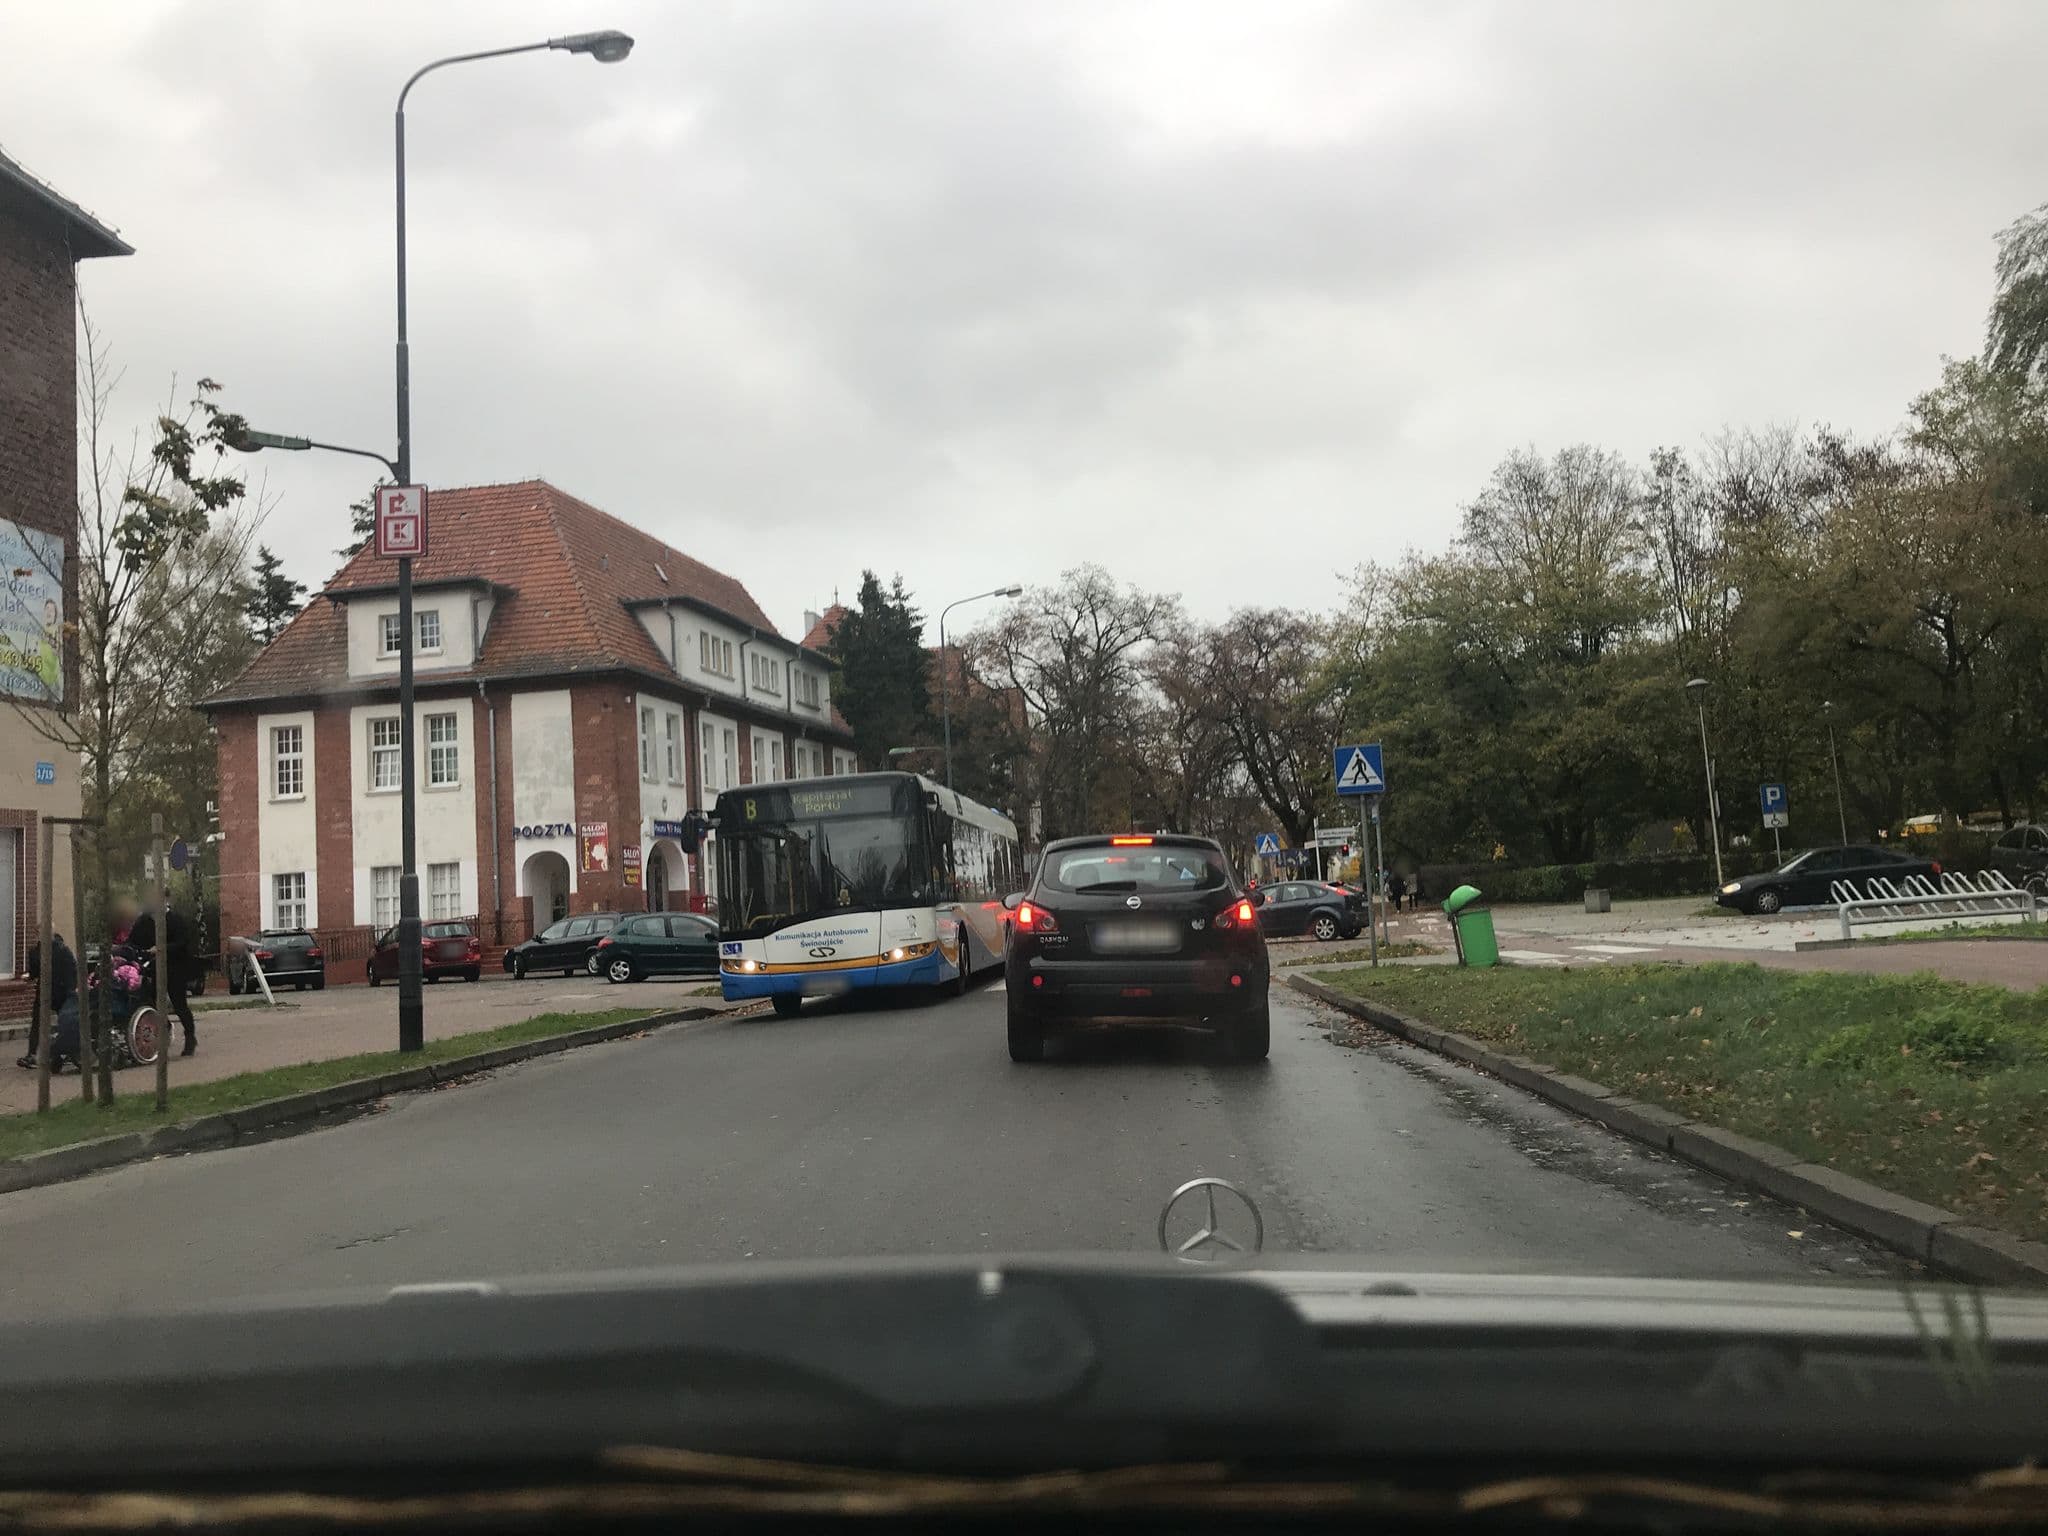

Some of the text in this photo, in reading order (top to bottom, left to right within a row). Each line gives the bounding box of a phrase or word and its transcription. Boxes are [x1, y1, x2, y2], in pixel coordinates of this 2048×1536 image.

[1766, 787, 1780, 805] P
[746, 799, 757, 820] B
[512, 823, 574, 839] POCZTA
[582, 825, 606, 833] SALON
[775, 927, 869, 941] Komunikacja Autobusowa
